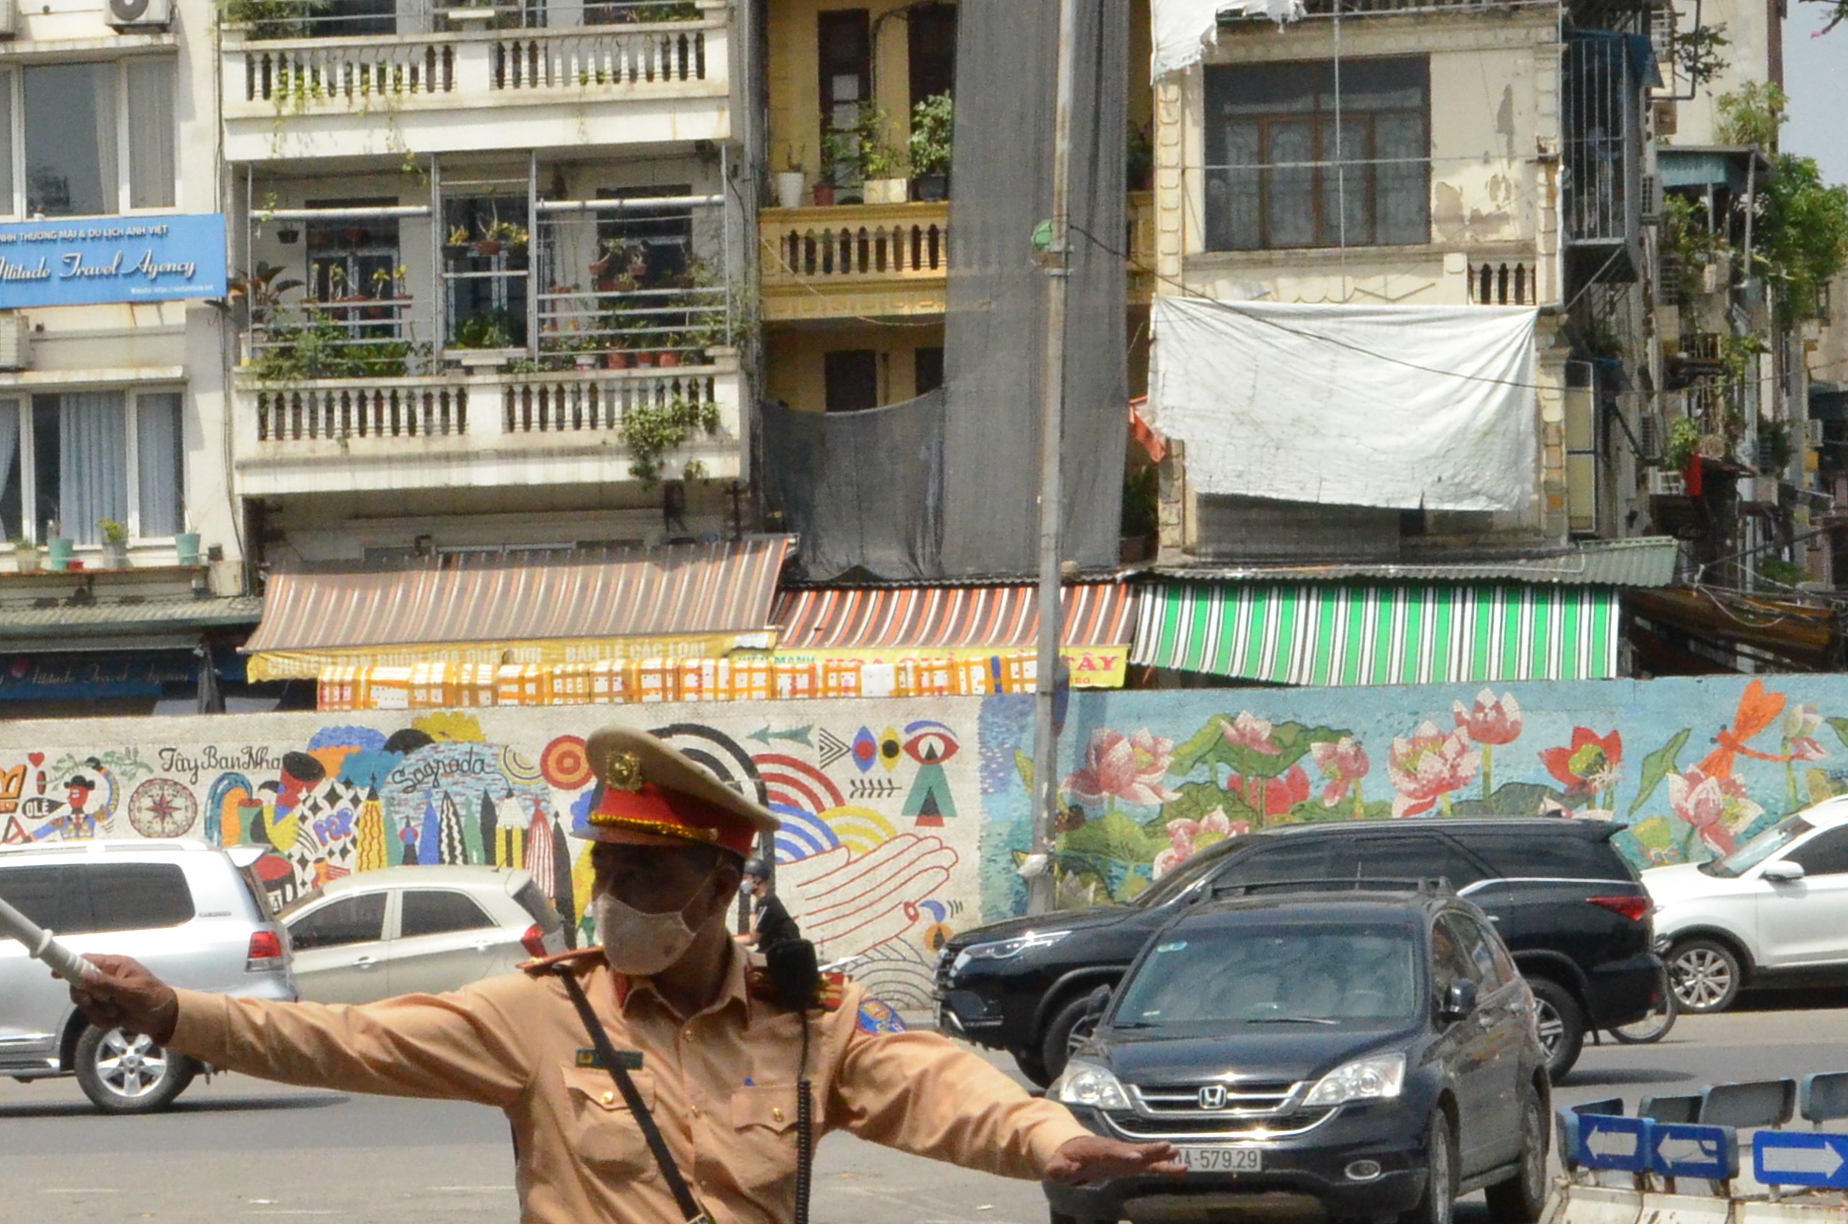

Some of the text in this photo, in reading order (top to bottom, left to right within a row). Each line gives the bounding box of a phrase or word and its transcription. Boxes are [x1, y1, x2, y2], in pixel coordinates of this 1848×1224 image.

[78, 228, 87, 239] &
[126, 224, 146, 236] ANH
[58, 249, 122, 279] Travel
[120, 248, 197, 280] Agency
[158, 747, 199, 785] Tây
[240, 745, 281, 770] Nha
[313, 807, 354, 847] POP
